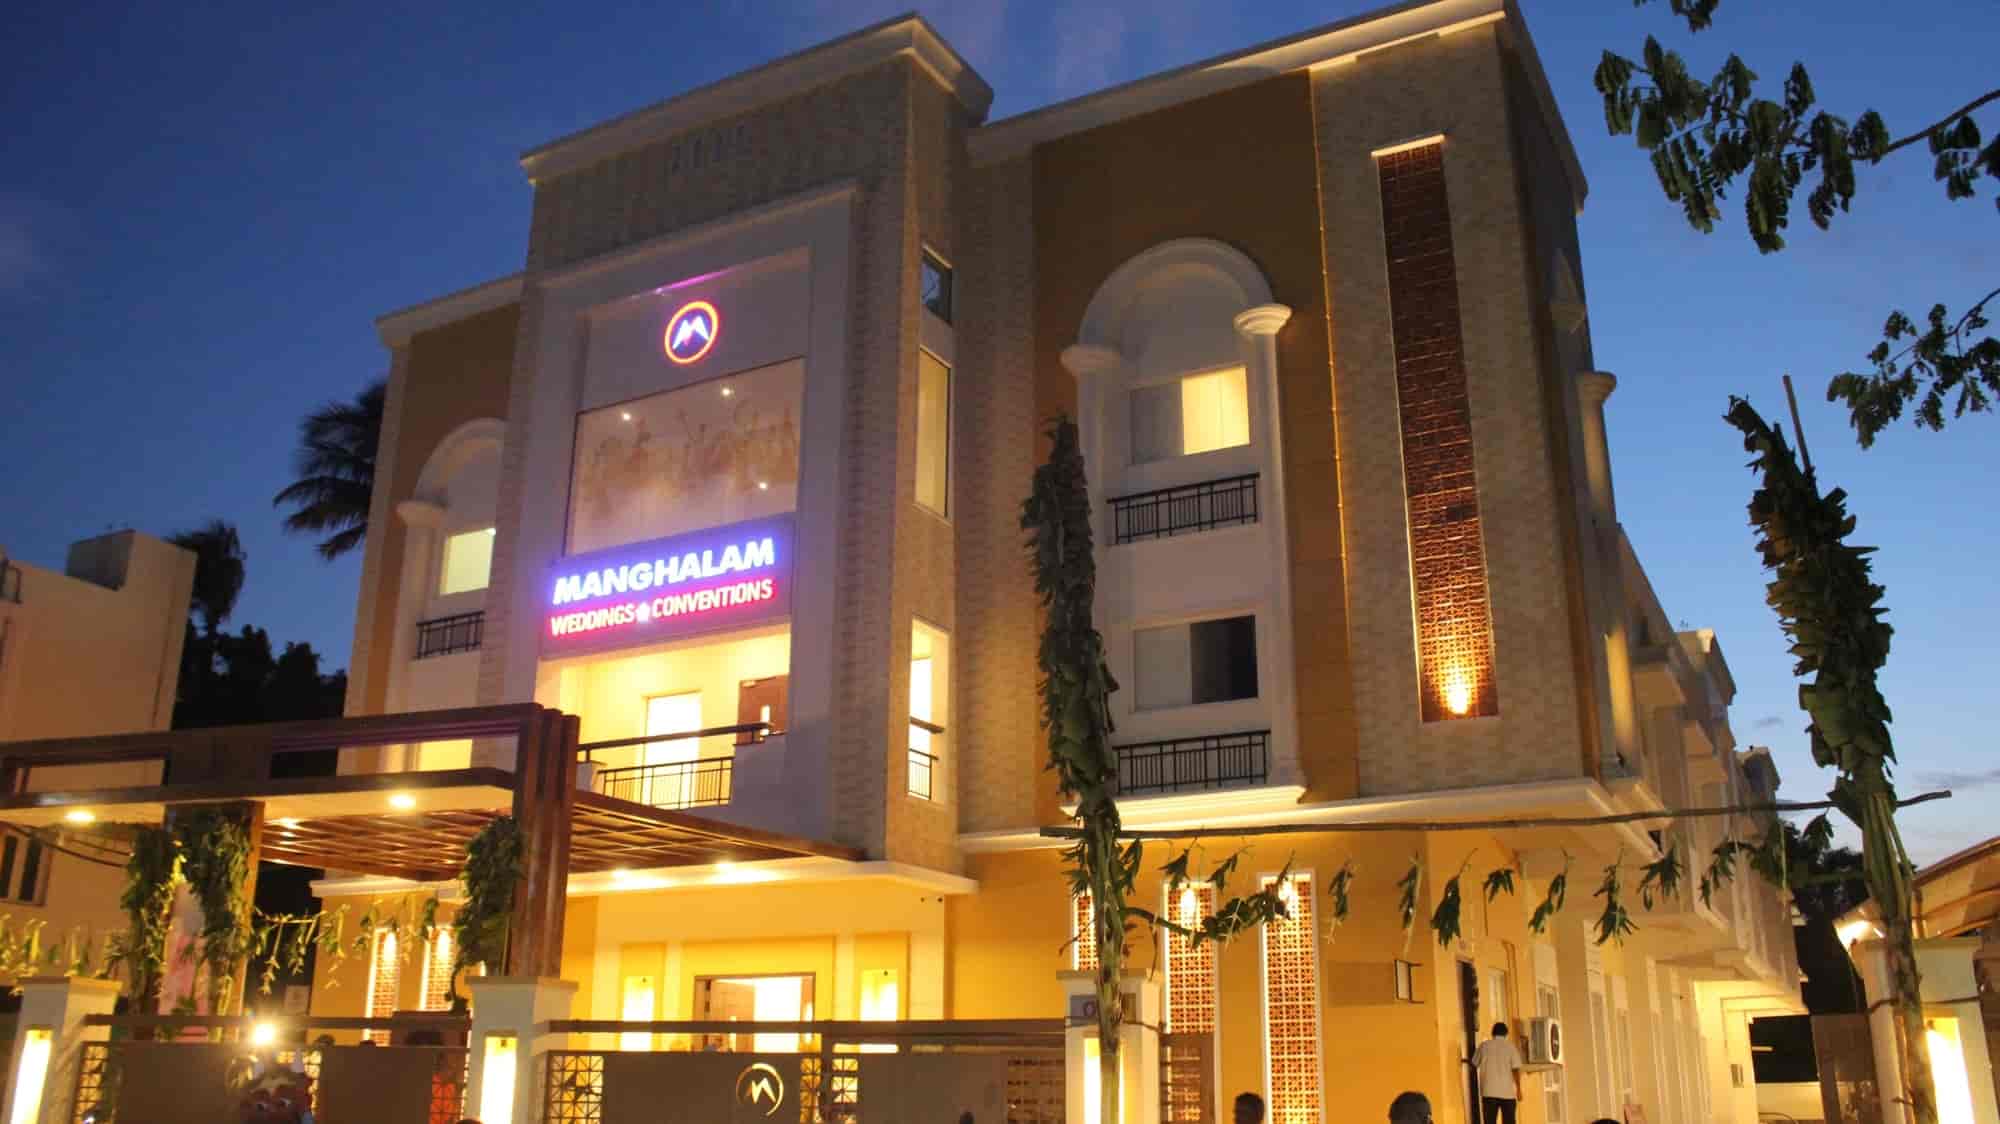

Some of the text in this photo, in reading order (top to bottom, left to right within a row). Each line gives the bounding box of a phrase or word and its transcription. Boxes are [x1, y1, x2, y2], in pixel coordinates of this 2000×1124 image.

[554, 538, 775, 605] MANGHALAM
[551, 602, 635, 637] WEDDINGS
[653, 579, 773, 618] CONVENTIONS
